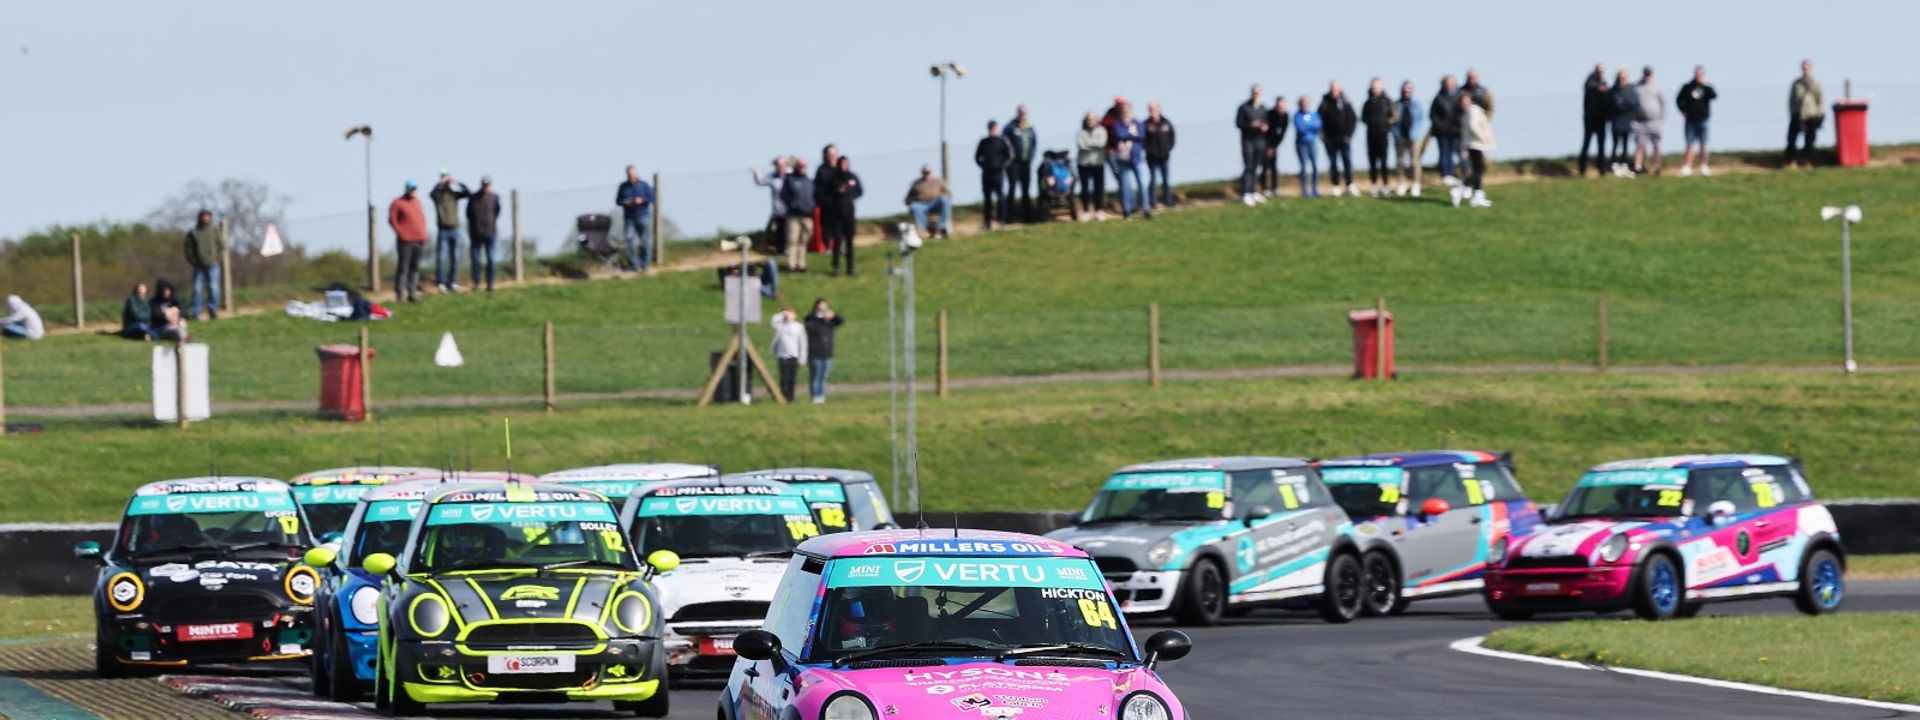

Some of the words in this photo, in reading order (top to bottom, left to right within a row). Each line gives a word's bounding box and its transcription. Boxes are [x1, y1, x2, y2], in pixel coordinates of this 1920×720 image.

[552, 491, 590, 501] OILS
[676, 486, 745, 495] MILLERS
[748, 485, 783, 495] OILS
[190, 495, 260, 509] VERTU
[701, 497, 773, 512] VERTU
[497, 504, 577, 518] VERTU
[580, 522, 618, 532] SOLLEY
[600, 530, 626, 553] 12
[901, 541, 1006, 554] MILLERS
[1010, 541, 1063, 554] OILS
[850, 565, 881, 575] MINI
[934, 562, 1045, 583] VERTU
[1055, 566, 1086, 577] MINI
[1041, 588, 1107, 602] HICKTON
[1076, 597, 1118, 630] 64
[188, 623, 239, 636] MINTEX
[520, 656, 559, 667] SCORPION
[904, 667, 1070, 682] HYSONS
